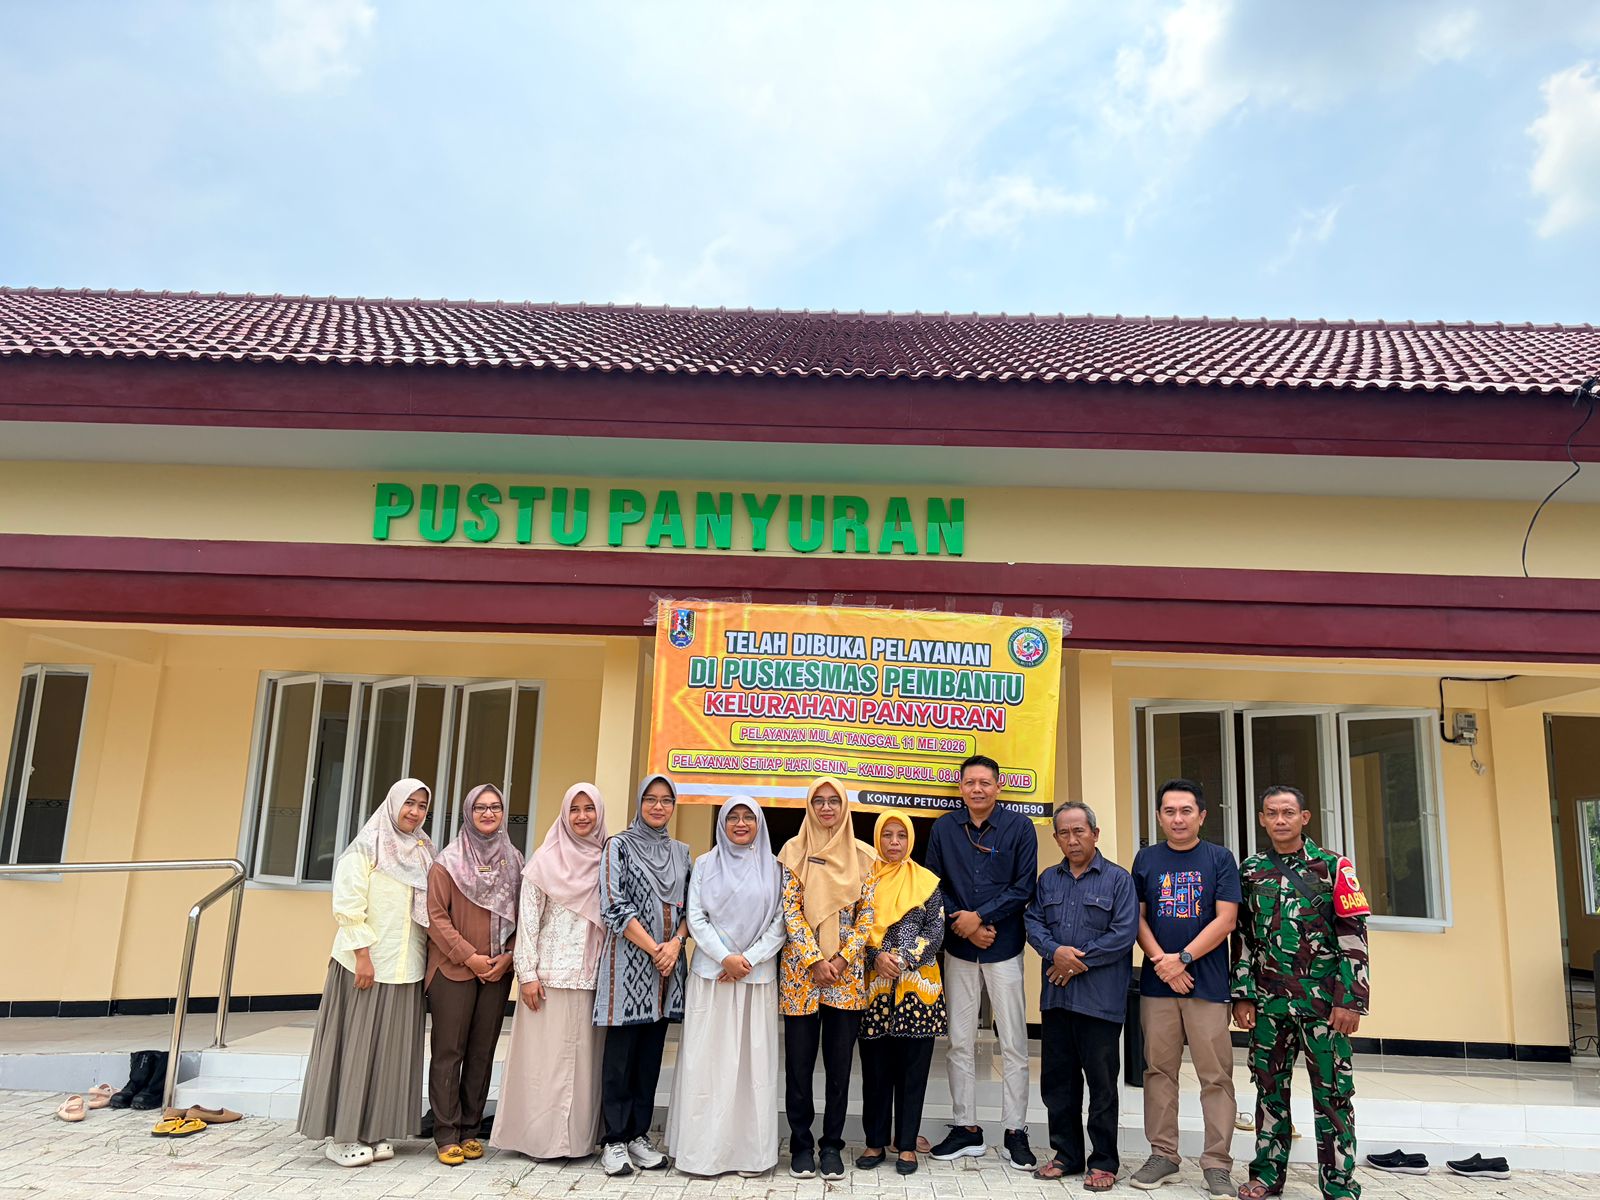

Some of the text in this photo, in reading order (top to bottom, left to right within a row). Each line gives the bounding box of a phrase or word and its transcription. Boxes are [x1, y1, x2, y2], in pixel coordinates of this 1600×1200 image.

[372, 482, 966, 556] PUSTU PANYURAN
[725, 631, 990, 666] TELAH DIBUKA PELAYANAN
[689, 657, 1023, 704] DI PUSKESMAS PEMBANTU
[705, 692, 1005, 731] KELURAHAN PANYURAN
[740, 727, 966, 752] PELAYANAN MULAI TANGGAL 11 MEI 2026
[672, 755, 739, 769] PELAYANAN
[742, 757, 782, 771] SETIAP
[785, 758, 811, 771] HARI
[814, 759, 847, 773] SENIN
[858, 763, 895, 777] KAMIS
[896, 766, 936, 781] PUKUL
[938, 768, 960, 782] 08.0
[1008, 774, 1032, 788] WIB
[867, 794, 911, 806] KONTAK
[914, 797, 962, 809] PETUGAS
